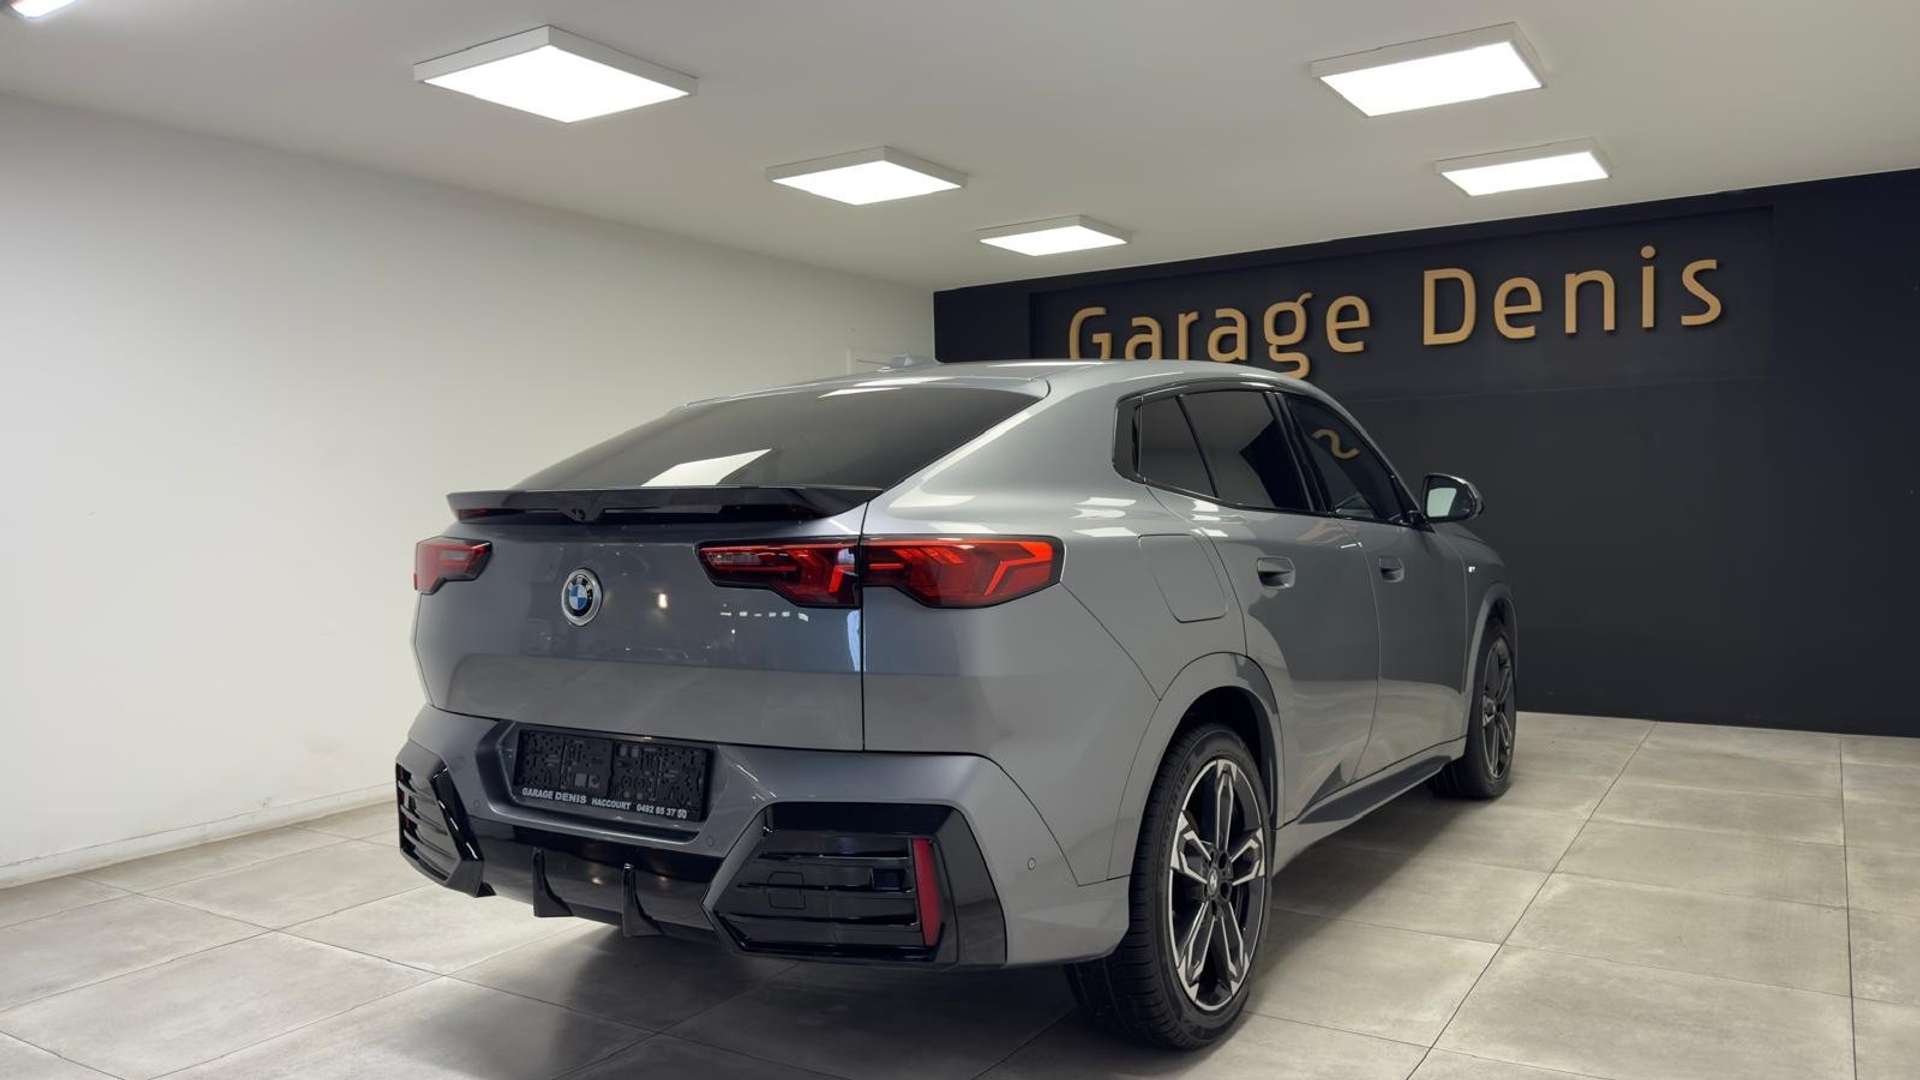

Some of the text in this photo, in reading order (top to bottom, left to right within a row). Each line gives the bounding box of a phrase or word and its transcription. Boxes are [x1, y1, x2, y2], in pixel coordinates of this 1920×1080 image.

[1068, 245, 1723, 379] Garage Denis
[522, 787, 554, 800] GARAGE
[555, 791, 587, 804] DENIS
